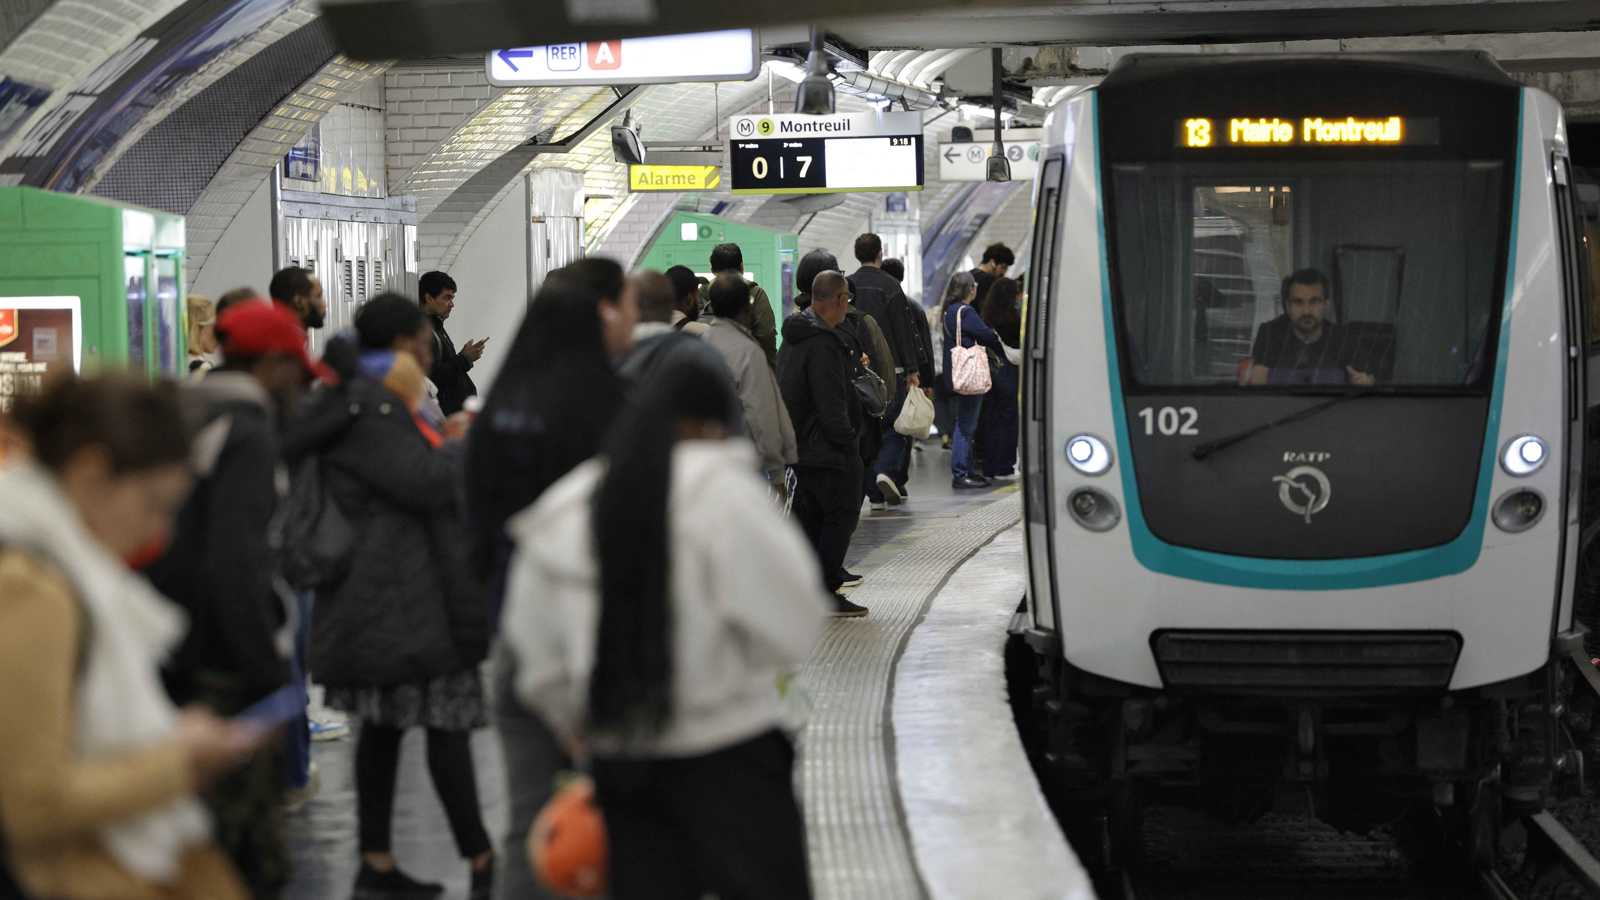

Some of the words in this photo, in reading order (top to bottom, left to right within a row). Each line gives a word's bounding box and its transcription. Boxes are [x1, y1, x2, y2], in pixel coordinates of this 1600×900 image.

[551, 46, 577, 60] RER
[594, 42, 615, 64] A
[761, 121, 770, 133] 9
[780, 119, 851, 133] Montreuil
[1185, 118, 1211, 147] 13
[1303, 116, 1401, 142] Montreuil
[638, 171, 697, 185] Alarme
[752, 156, 768, 179] 0
[796, 155, 813, 178] 7
[1138, 406, 1199, 436] 102
[1282, 451, 1331, 463] RATP
